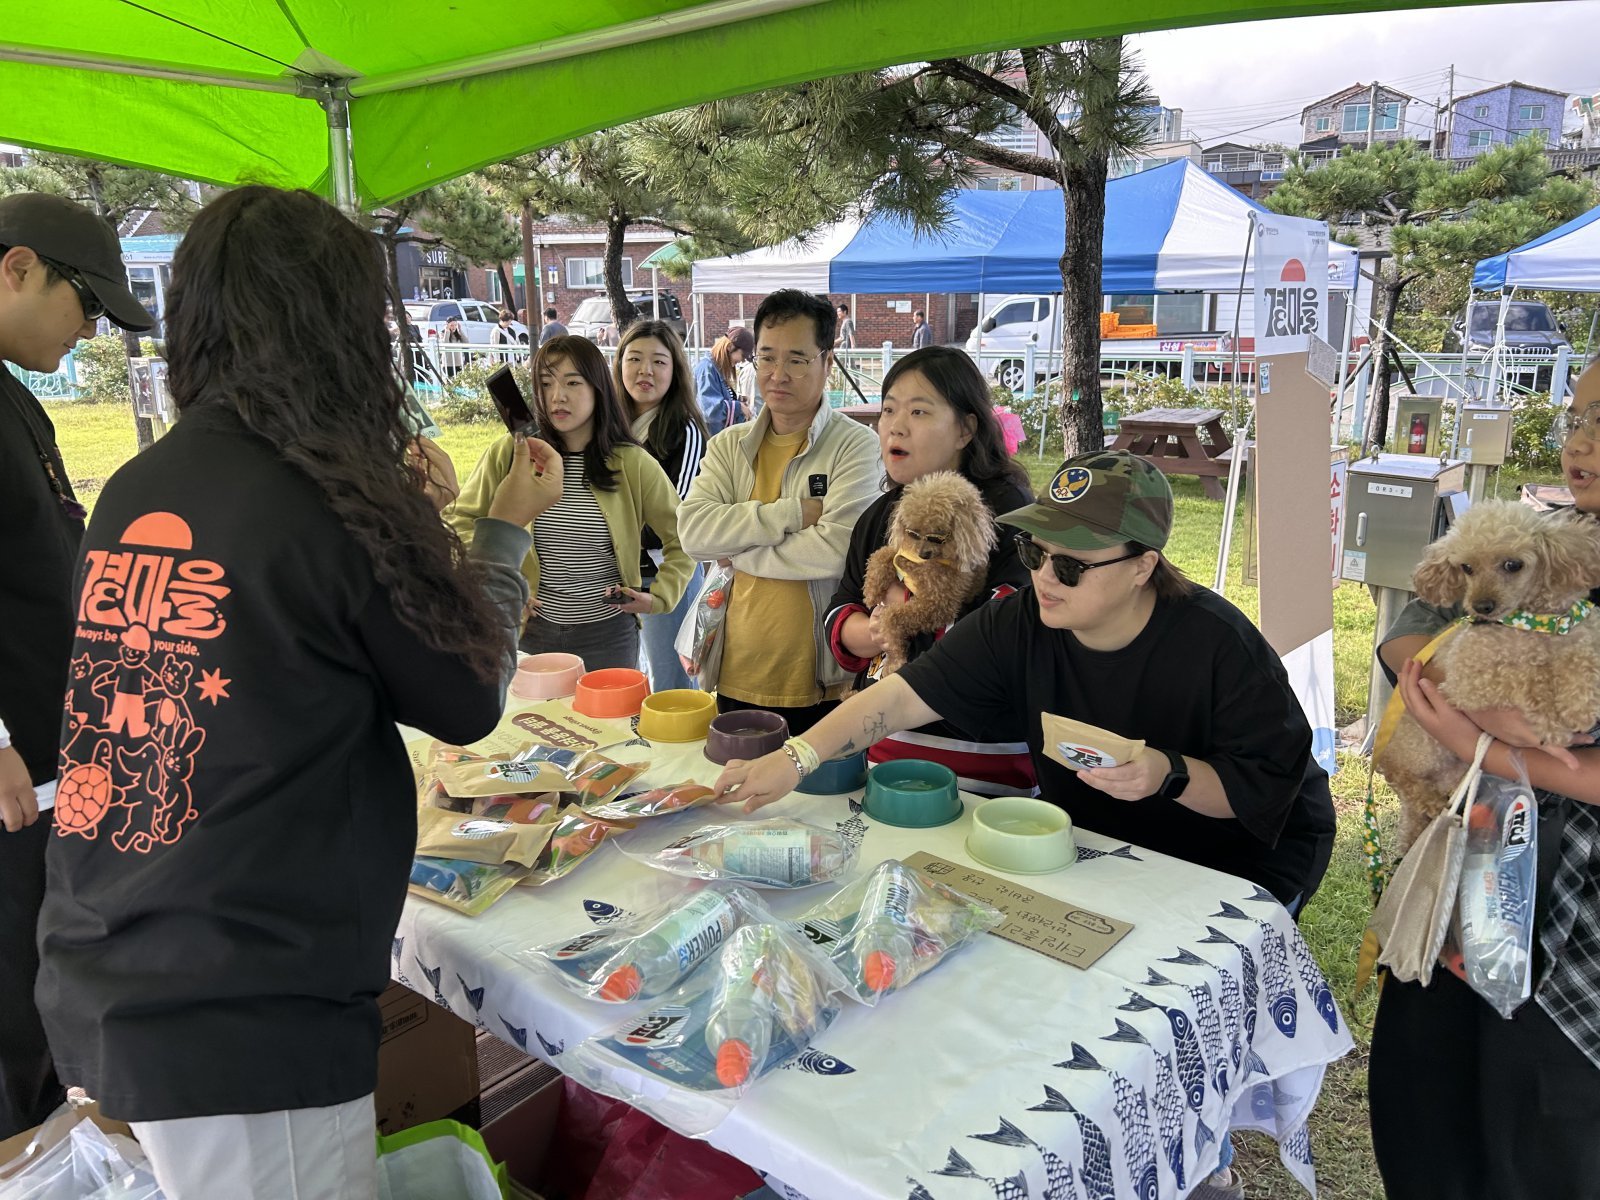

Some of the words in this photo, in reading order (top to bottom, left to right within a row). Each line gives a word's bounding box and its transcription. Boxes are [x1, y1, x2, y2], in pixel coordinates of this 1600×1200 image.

[75, 625, 103, 643] lways
[104, 629, 118, 642] be
[153, 640, 176, 653] your
[176, 640, 200, 657] side.
[686, 919, 722, 963] POWER
